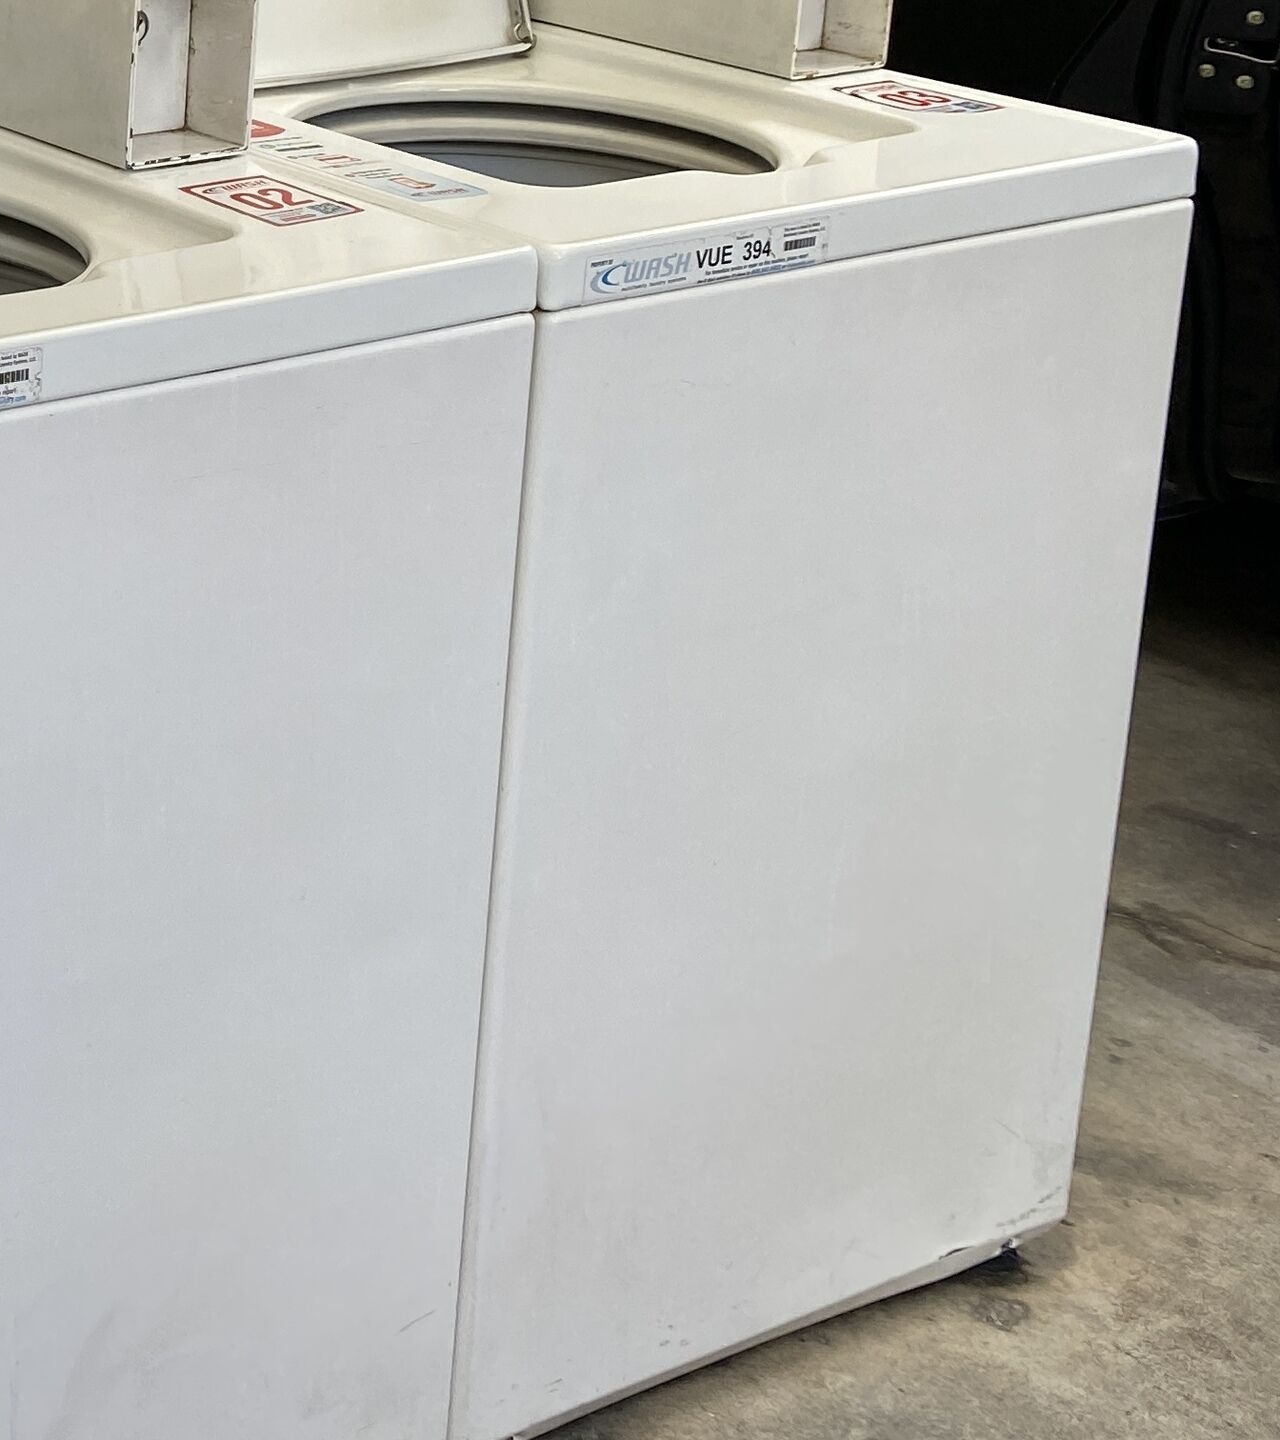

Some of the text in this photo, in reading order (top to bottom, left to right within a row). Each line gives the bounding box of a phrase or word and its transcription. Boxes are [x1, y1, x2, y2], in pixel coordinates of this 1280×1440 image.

[230, 188, 316, 210] 02
[624, 252, 692, 283] WASH
[696, 245, 733, 269] VUE
[743, 240, 771, 261] 394
